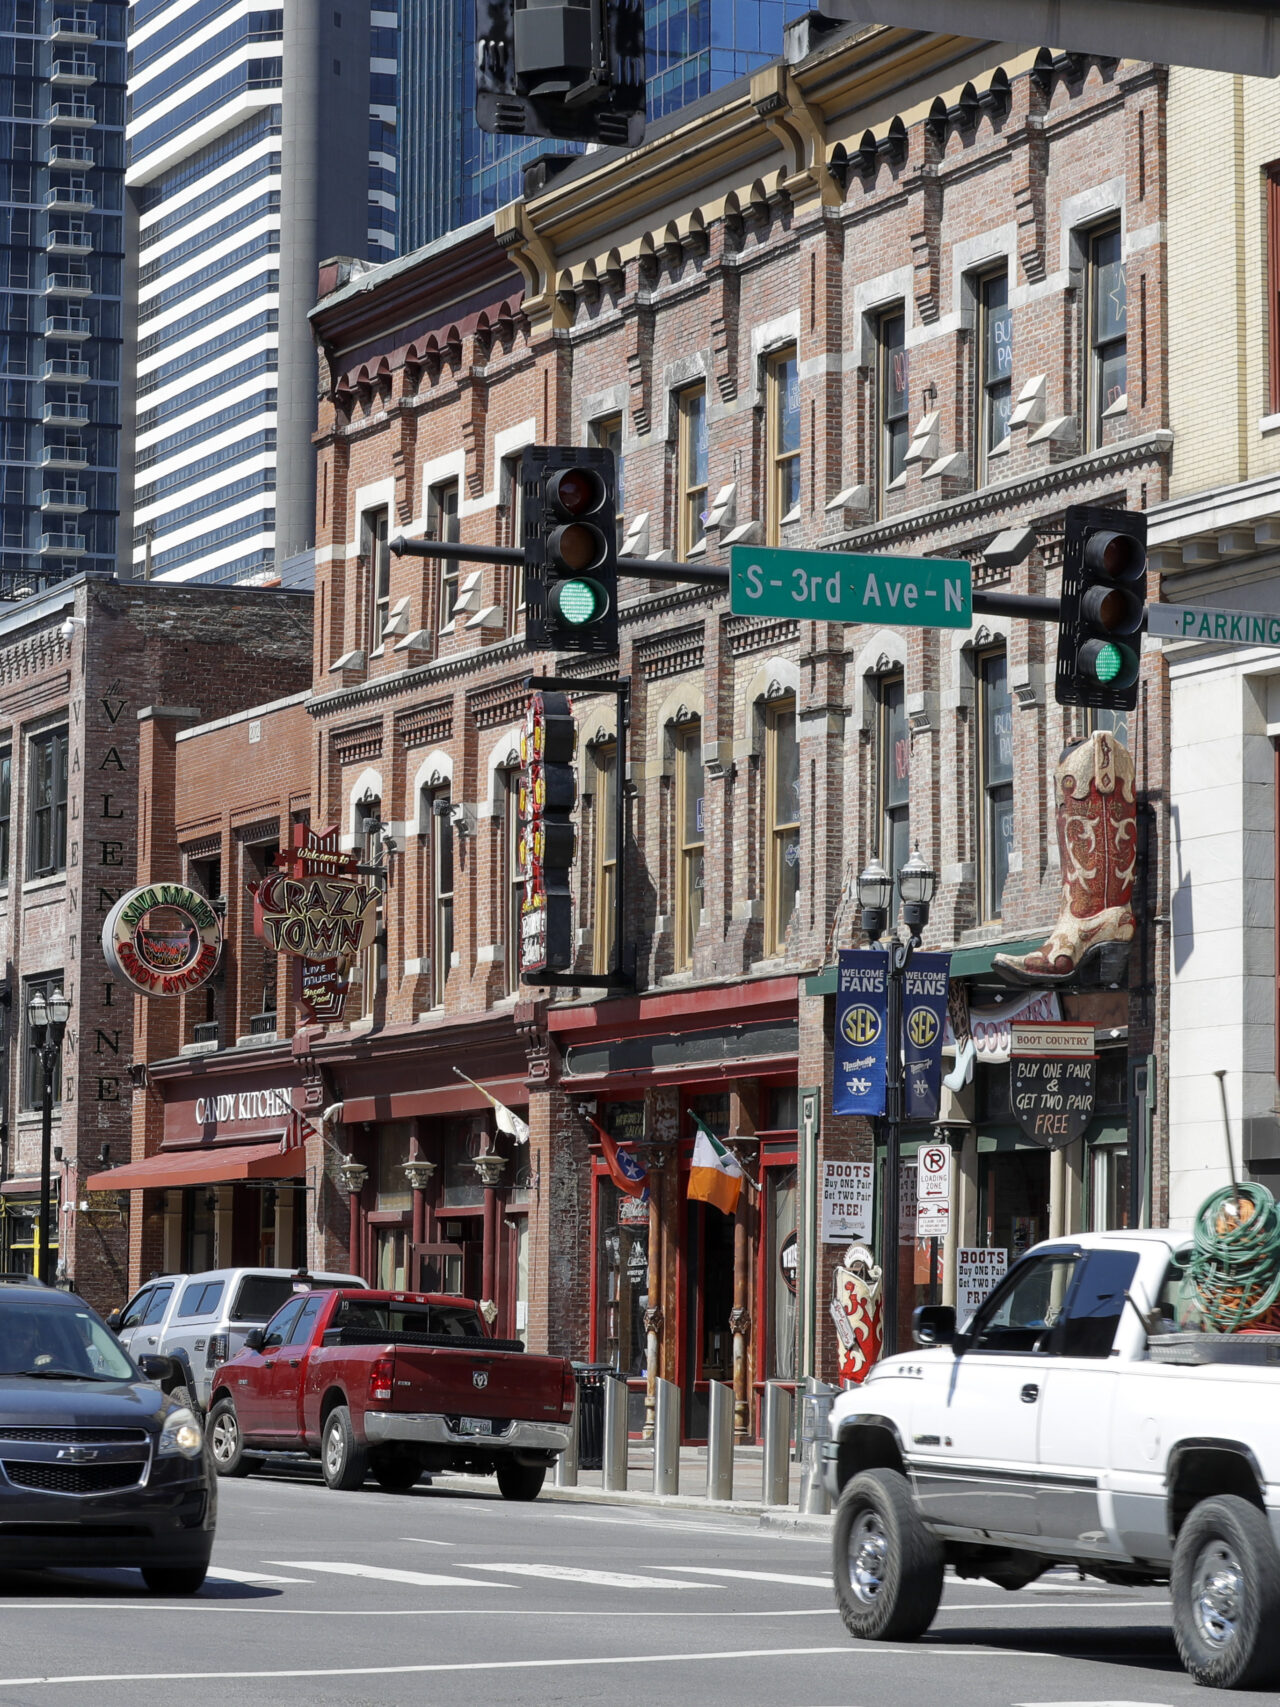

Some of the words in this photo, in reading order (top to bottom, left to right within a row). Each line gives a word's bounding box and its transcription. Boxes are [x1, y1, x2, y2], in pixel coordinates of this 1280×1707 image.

[997, 347, 1012, 370] PA
[745, 564, 841, 604] S-3rd
[862, 571, 962, 612] Ave-N
[1182, 611, 1280, 643] PARKING
[297, 848, 338, 862] Welcome
[339, 854, 350, 864] to
[94, 700, 127, 1101] VALENINE
[258, 873, 381, 918] CRAZY
[263, 915, 364, 952] TOWN
[118, 942, 160, 990] CANDY
[162, 944, 217, 993] KITCHEN
[304, 964, 326, 975] LIVE
[841, 968, 884, 978] WELCOME
[905, 971, 947, 981] WELCOME
[303, 986, 326, 998] Great
[841, 977, 884, 993] FANS
[905, 980, 946, 996] FANS
[312, 994, 331, 1005] Food
[845, 1009, 876, 1042] SEC
[911, 1011, 935, 1044] SEC
[1017, 1036, 1042, 1045] BOOT
[1046, 1036, 1089, 1046] COUNTRY
[1017, 1063, 1040, 1078] BUY
[1043, 1063, 1063, 1078] ONE
[1066, 1063, 1091, 1079] PAIR
[1046, 1079, 1059, 1092] &
[195, 1094, 237, 1124] CANDY
[238, 1087, 293, 1120] KITCHEN
[1016, 1093, 1040, 1110] GET
[1040, 1094, 1063, 1110] TWO
[1066, 1095, 1093, 1111] PAIR
[1034, 1114, 1069, 1135] FREE
[826, 1164, 871, 1178] BOOTS
[824, 1178, 838, 1190] Buy
[840, 1179, 854, 1189] ONE
[857, 1179, 872, 1189] Pair
[824, 1191, 836, 1200] Get
[838, 1191, 855, 1200] TWO
[857, 1191, 872, 1201] Pair
[832, 1203, 863, 1217] FREE!
[960, 1251, 1005, 1264] BOOTS
[959, 1266, 973, 1276] Buy
[974, 1266, 989, 1275] ONE
[991, 1266, 1006, 1275] Pair
[958, 1278, 970, 1288] Get
[972, 1278, 989, 1288] TWO
